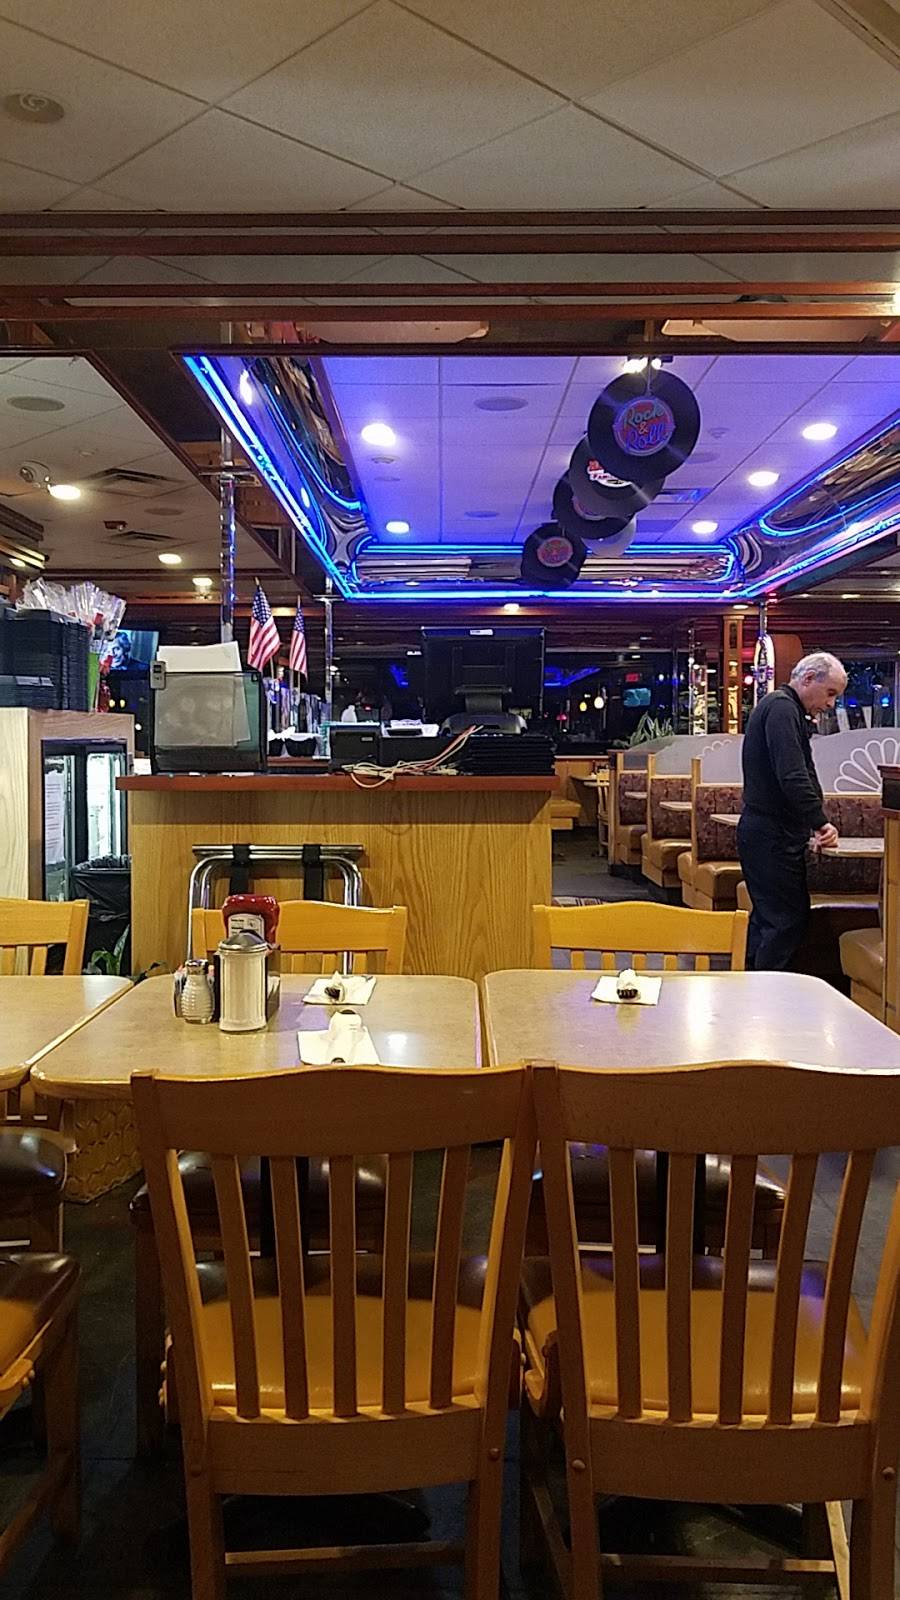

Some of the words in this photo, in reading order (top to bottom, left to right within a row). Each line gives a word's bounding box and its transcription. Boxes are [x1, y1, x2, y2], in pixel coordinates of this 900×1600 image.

[624, 400, 665, 428] Rock
[626, 423, 667, 449] Roll
[638, 421, 649, 434] &
